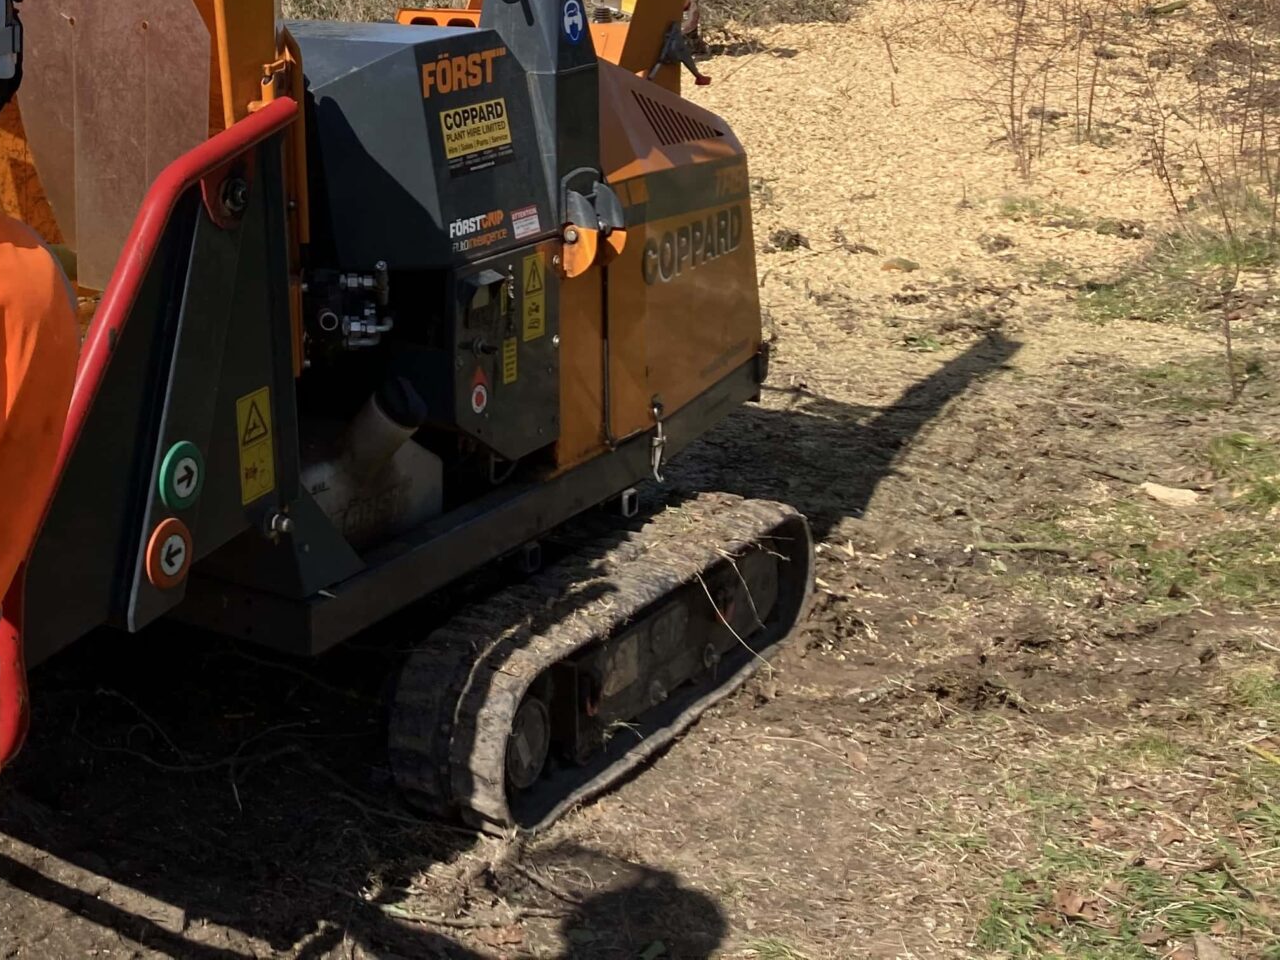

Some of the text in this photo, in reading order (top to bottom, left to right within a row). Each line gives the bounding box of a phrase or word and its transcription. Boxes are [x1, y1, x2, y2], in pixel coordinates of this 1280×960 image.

[422, 47, 506, 98] FÖRST
[444, 102, 504, 131] COPPARD
[446, 121, 506, 144] PLANT HIRE LIMITED
[642, 205, 742, 286] COPPARD
